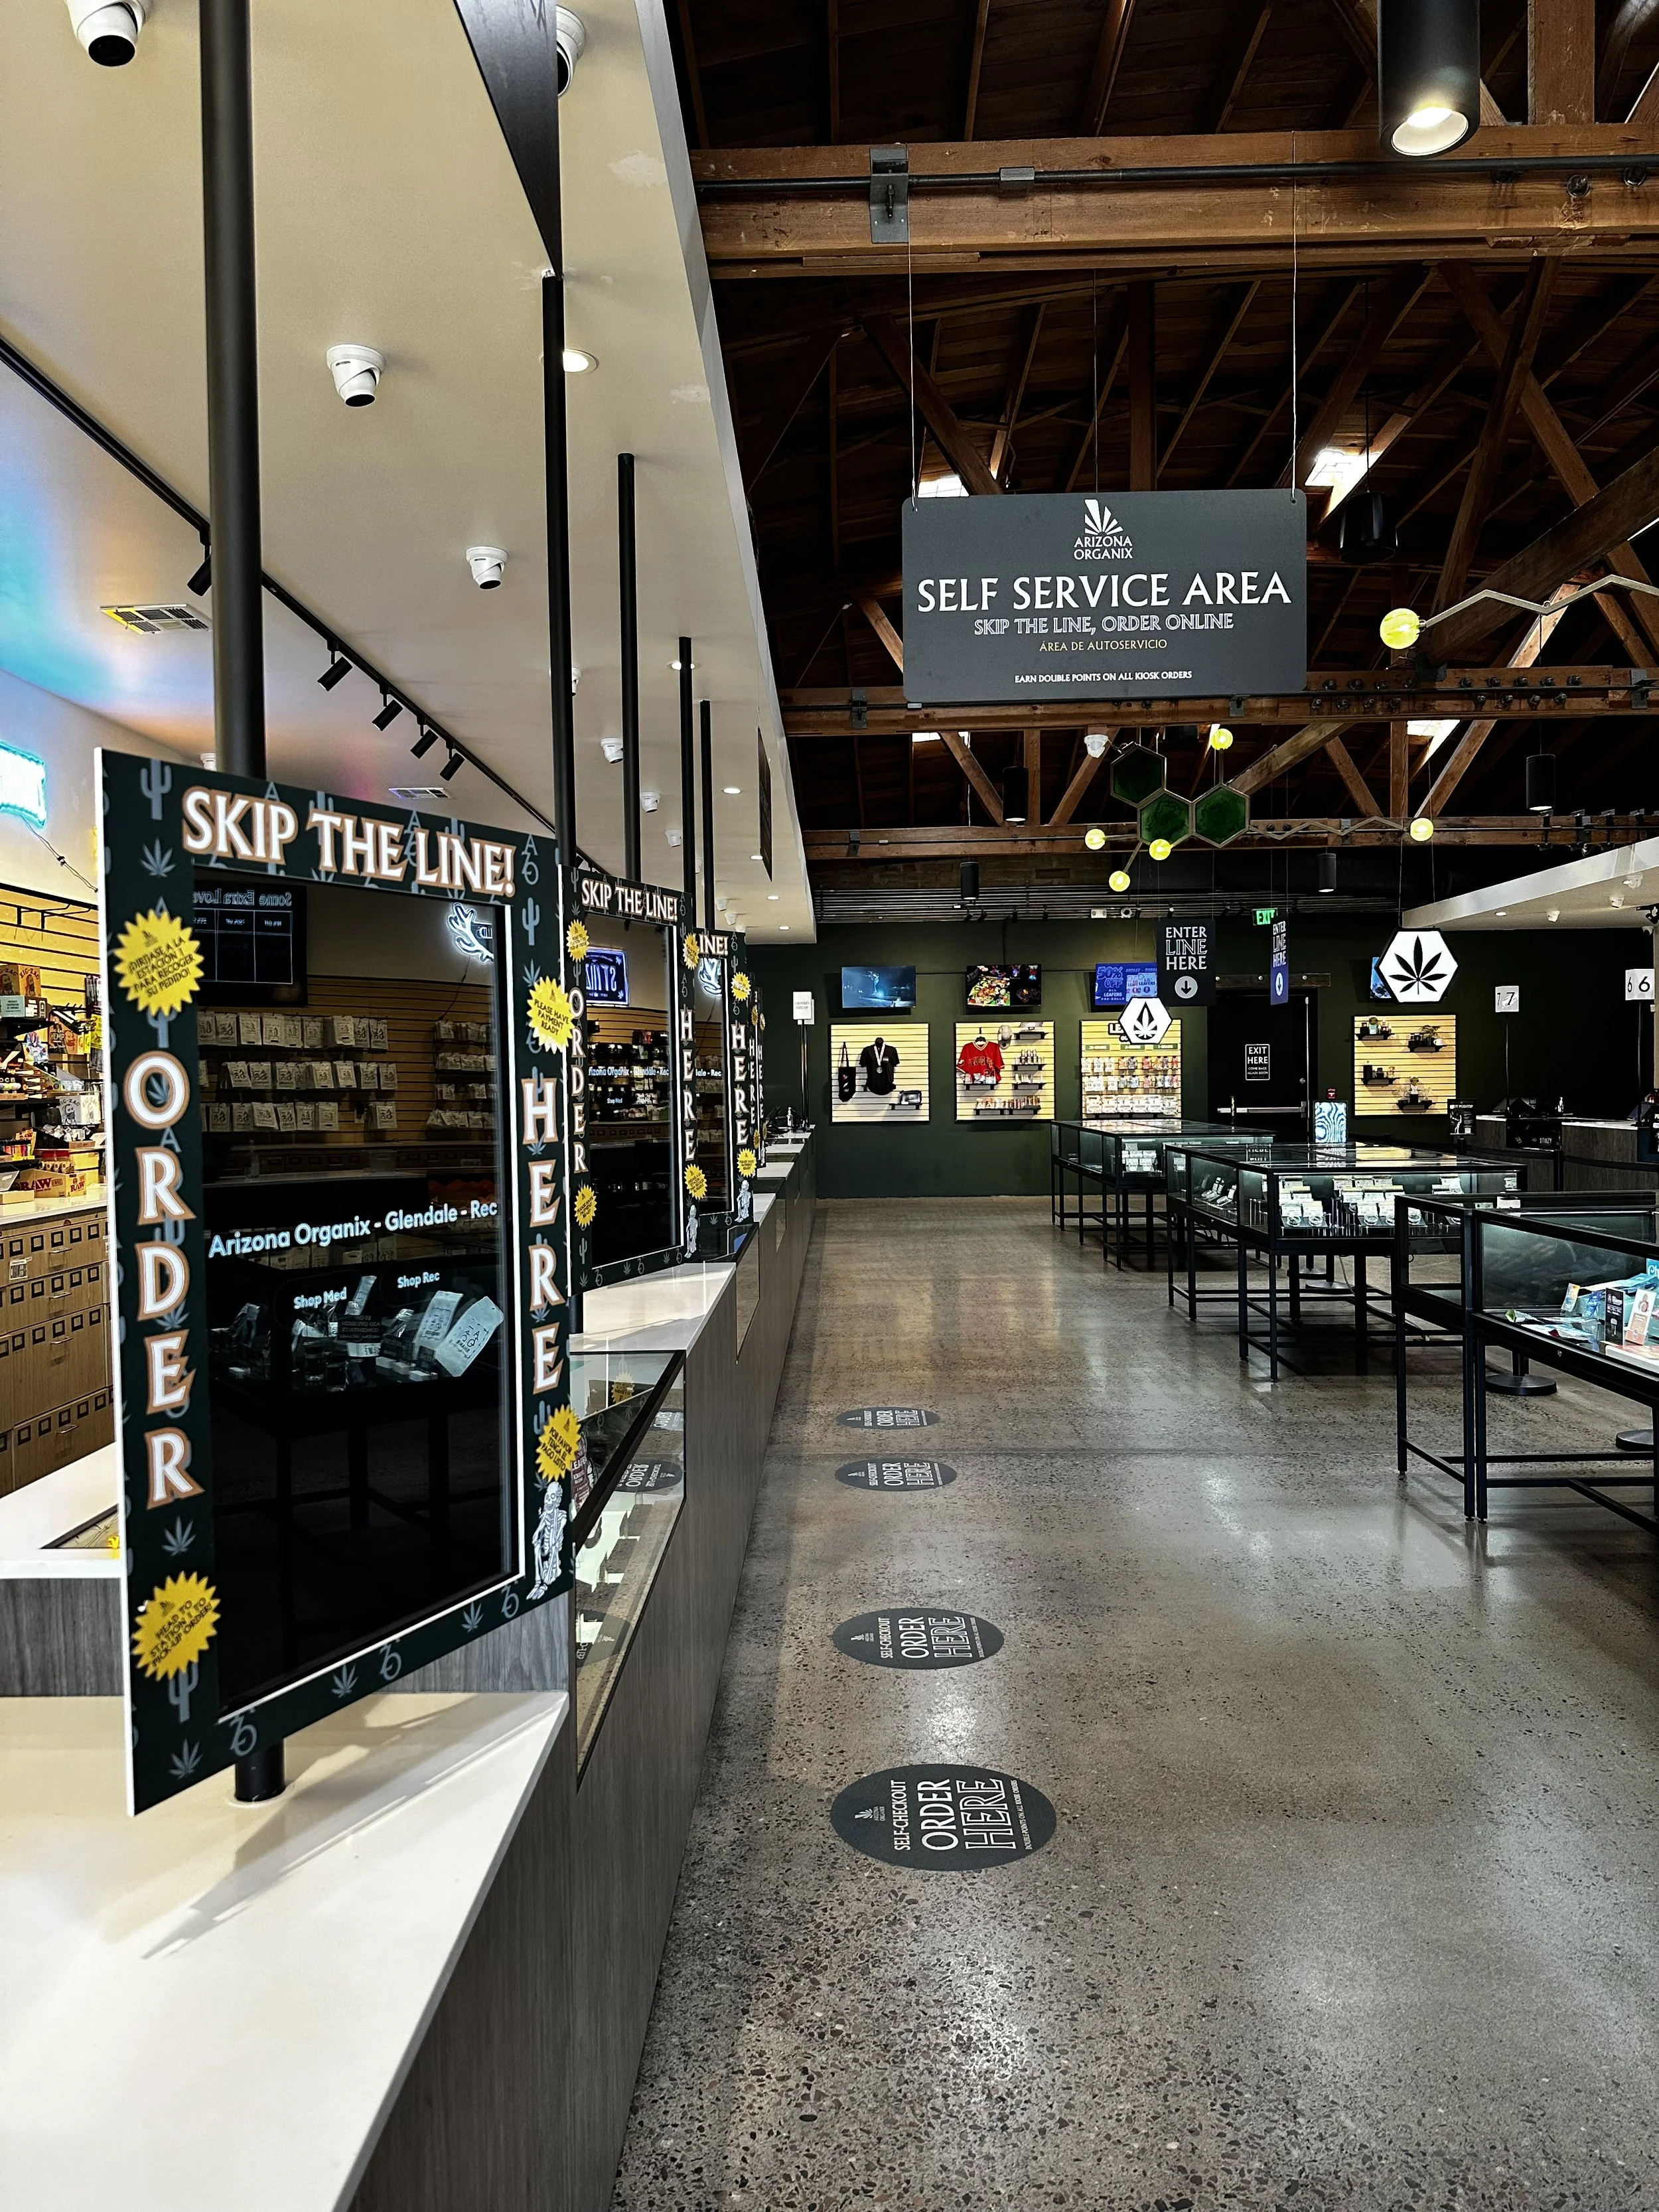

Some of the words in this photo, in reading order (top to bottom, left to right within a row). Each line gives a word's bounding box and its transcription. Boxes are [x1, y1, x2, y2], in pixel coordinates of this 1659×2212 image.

[1074, 536, 1132, 548] ARIZONA
[1074, 548, 1133, 560] ORGANIX
[917, 577, 999, 613] SELF
[1013, 573, 1170, 610] SERVICE
[1182, 571, 1291, 606] AREA
[974, 619, 1009, 635] SKIP
[1014, 618, 1048, 634] THE
[1053, 616, 1096, 635] LINE,
[1102, 615, 1161, 631] ORDER
[1165, 613, 1234, 630] ONLINE
[1039, 640, 1068, 652] ÁREA
[1071, 640, 1085, 650] DE
[1087, 638, 1167, 650] AUTOSERVICIO
[1015, 674, 1037, 684] EARN
[1039, 674, 1070, 683] DOUBLE
[1071, 673, 1101, 682] POINTS
[1102, 672, 1117, 682] ON
[1118, 672, 1133, 681] ALL
[1135, 671, 1159, 680] KIOSK
[1161, 670, 1192, 680] ORDERS
[182, 786, 298, 865] SKIP
[307, 809, 407, 881] THE
[414, 829, 516, 897] LINE!
[581, 877, 612, 909] SKIP
[614, 886, 643, 917] THE
[646, 891, 678, 922] LINE!
[1256, 910, 1275, 924] EXIT
[1273, 921, 1286, 935] ENTER
[1166, 926, 1207, 938] ENTER
[1273, 933, 1286, 952] LINE
[697, 934, 729, 956] INE!
[1166, 938, 1208, 956] LINE
[1166, 956, 1207, 970] HERE
[1273, 951, 1286, 968] HERE
[1097, 966, 1123, 980] 50%
[1104, 978, 1123, 988] OFF
[1638, 976, 1650, 992] 6
[1627, 976, 1633, 993] 6
[1506, 992, 1515, 1005] 7
[534, 999, 553, 1015] PLEASE
[554, 1011, 569, 1025] HAVE
[538, 1009, 563, 1029] PAYMENT
[541, 1020, 559, 1035] READY
[569, 987, 589, 1173] ORDER
[680, 1009, 697, 1161] HERE
[731, 1023, 749, 1145] HERE
[20, 1178, 52, 1192] RAW
[70, 1181, 86, 1192] RAW
[208, 1231, 291, 1259] Arizona
[294, 1215, 371, 1246] Organix
[385, 1201, 458, 1232] Glendale
[470, 1200, 498, 1218] Rec
[522, 1077, 566, 1396] HERE
[123, 1050, 206, 1511] ORDER
[397, 1274, 422, 1289] Shop
[423, 1272, 441, 1285] Rec
[293, 1293, 322, 1309] Shop
[324, 1286, 347, 1305] Med
[547, 1437, 562, 1455] TENGA
[561, 1451, 567, 1461] EL
[549, 1426, 559, 1439] POR
[557, 1436, 573, 1455] FAVOR
[541, 1442, 555, 1459] PAGO
[553, 1455, 566, 1471] LISTO
[882, 1462, 904, 1486] ORDER
[903, 1462, 935, 1485] HERE
[878, 1617, 893, 1659] SELF-CHECKOUT
[899, 1616, 930, 1659] ORDER
[928, 1616, 973, 1658] HERE
[891, 1780, 911, 1851] SELF-CHECKOUT
[917, 1779, 959, 1851] ORDER
[956, 1778, 1017, 1850] HERE
